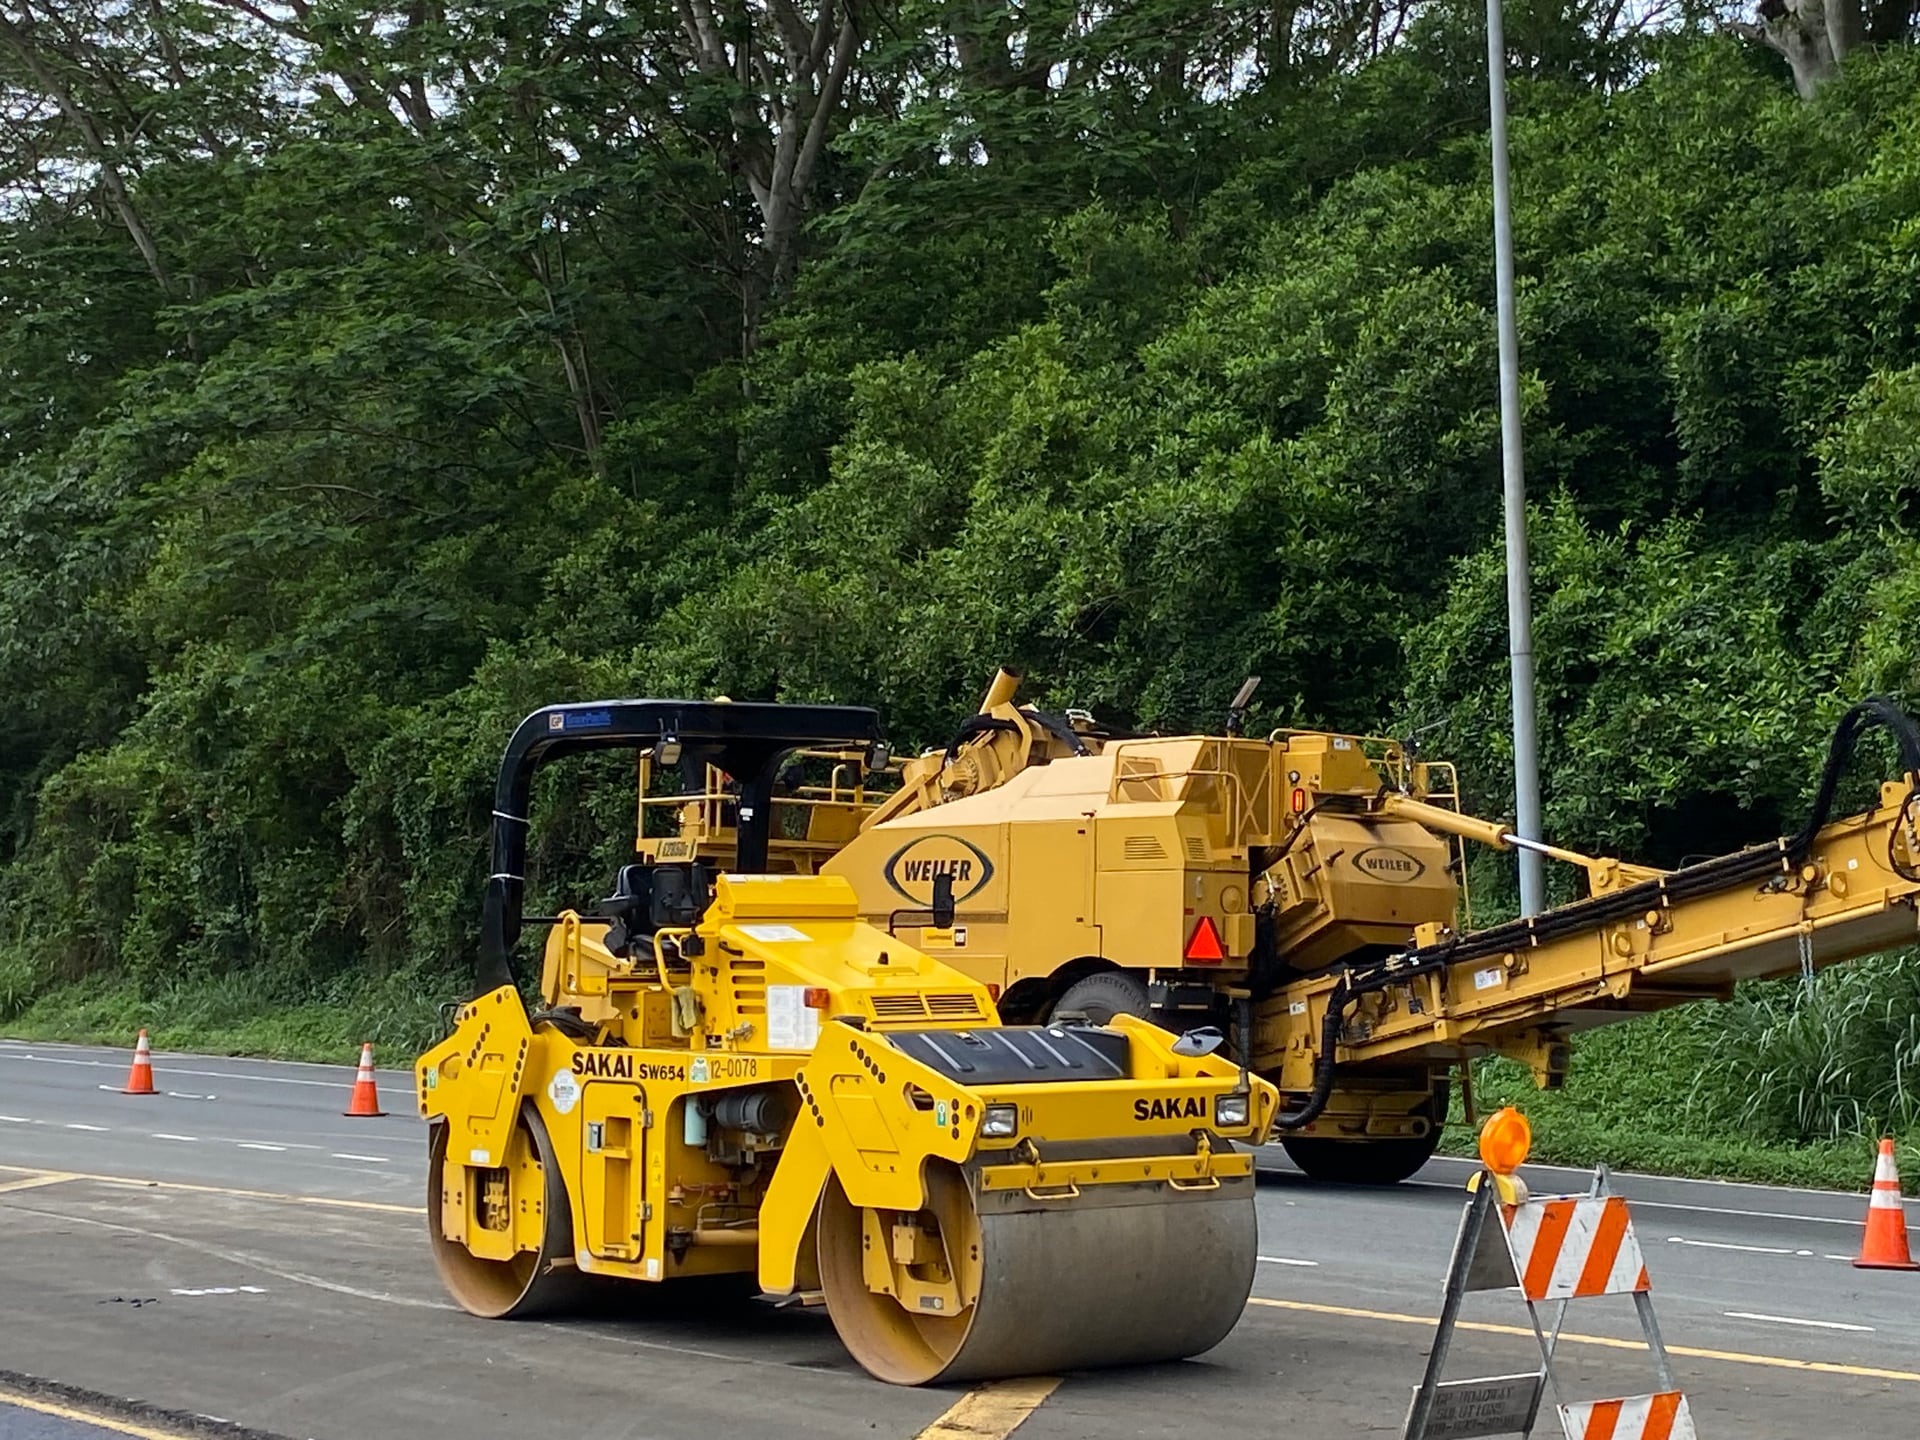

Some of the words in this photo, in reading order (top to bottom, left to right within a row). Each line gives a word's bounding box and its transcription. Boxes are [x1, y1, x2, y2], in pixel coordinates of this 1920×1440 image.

[905, 860, 971, 882] WEILER
[1365, 858, 1412, 872] WEILER
[571, 1052, 633, 1078] SAKAI
[639, 1064, 685, 1081] SW654
[710, 1059, 757, 1079] 12-0078
[1134, 1096, 1206, 1121] SAKAI
